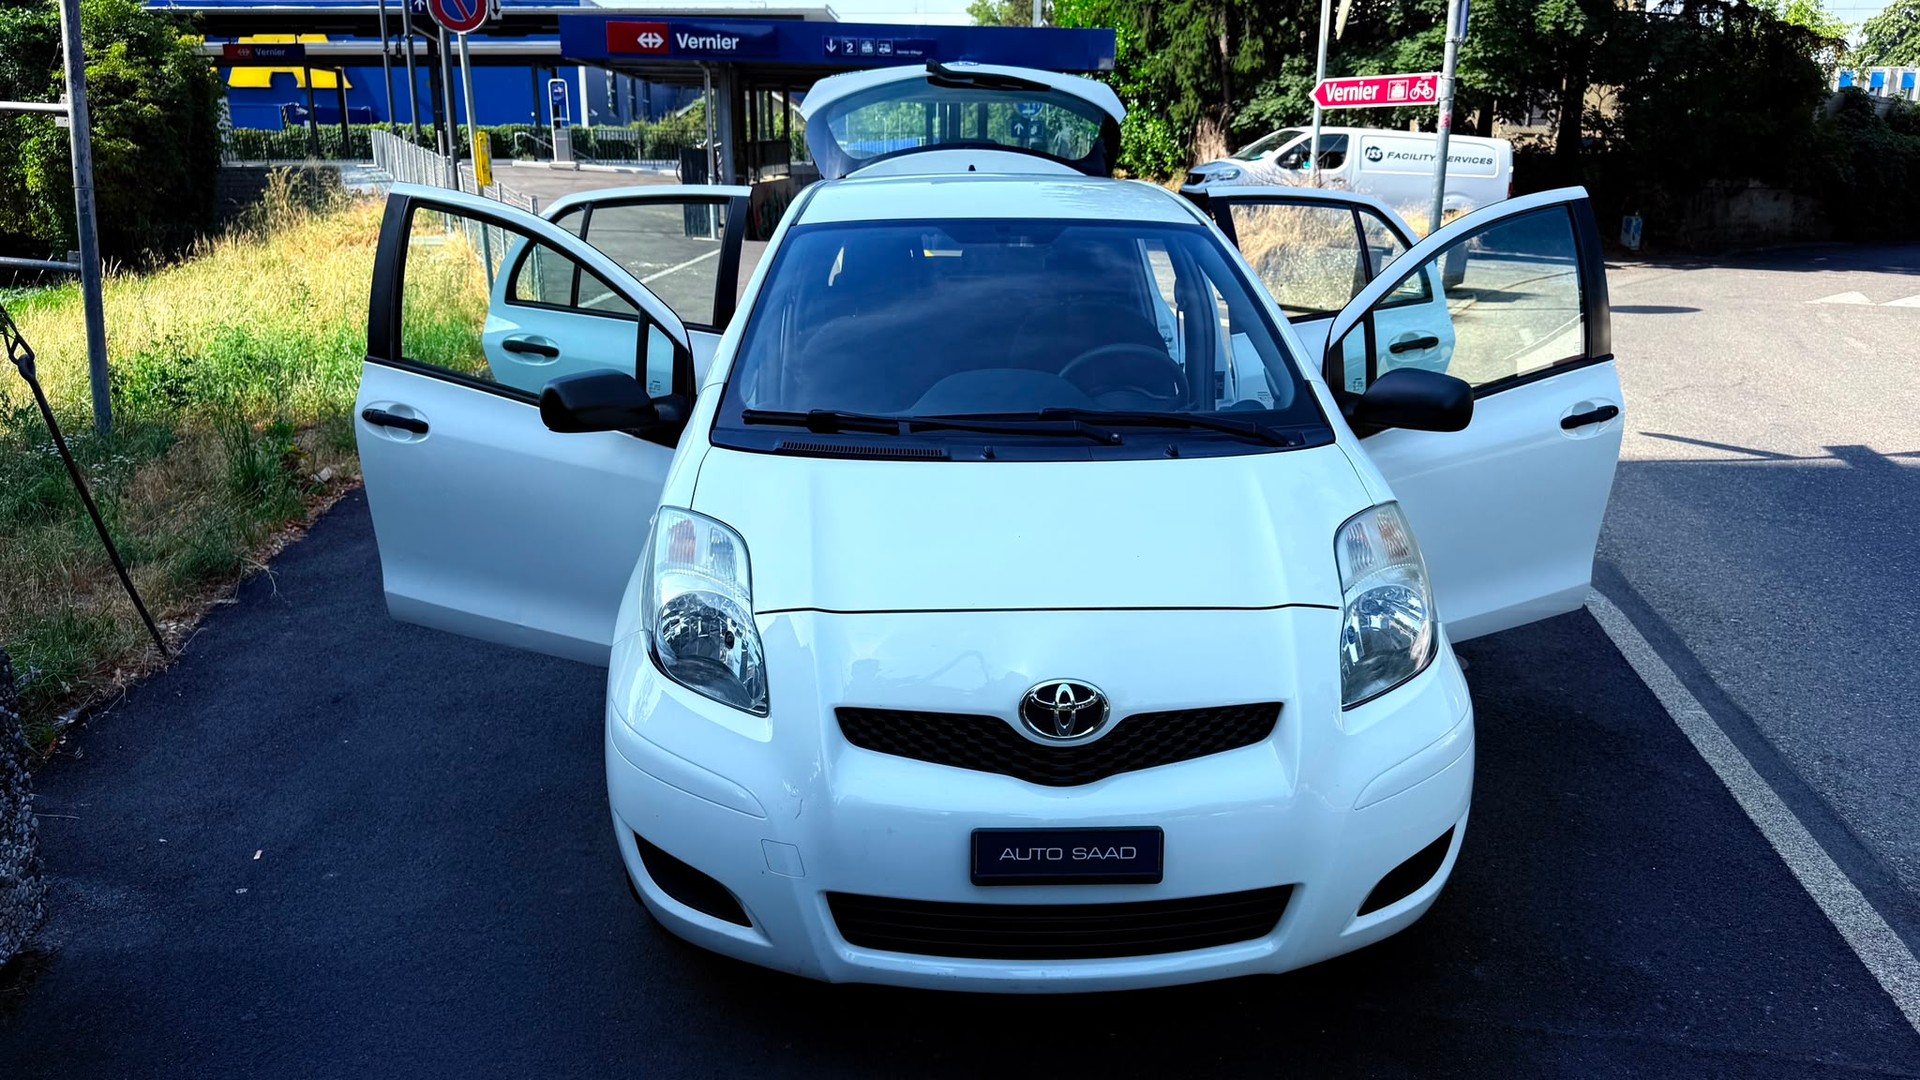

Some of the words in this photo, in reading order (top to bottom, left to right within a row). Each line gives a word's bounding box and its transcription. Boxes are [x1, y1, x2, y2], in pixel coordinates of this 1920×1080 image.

[676, 33, 739, 49] Vernier
[846, 42, 854, 53] 2
[255, 47, 286, 57] Vernier
[1325, 81, 1379, 102] Vernier
[1386, 151, 1436, 161] FACILITY
[1446, 155, 1494, 165] ERVICES
[999, 847, 1063, 861] AUTO
[1072, 846, 1137, 860] SAAD
